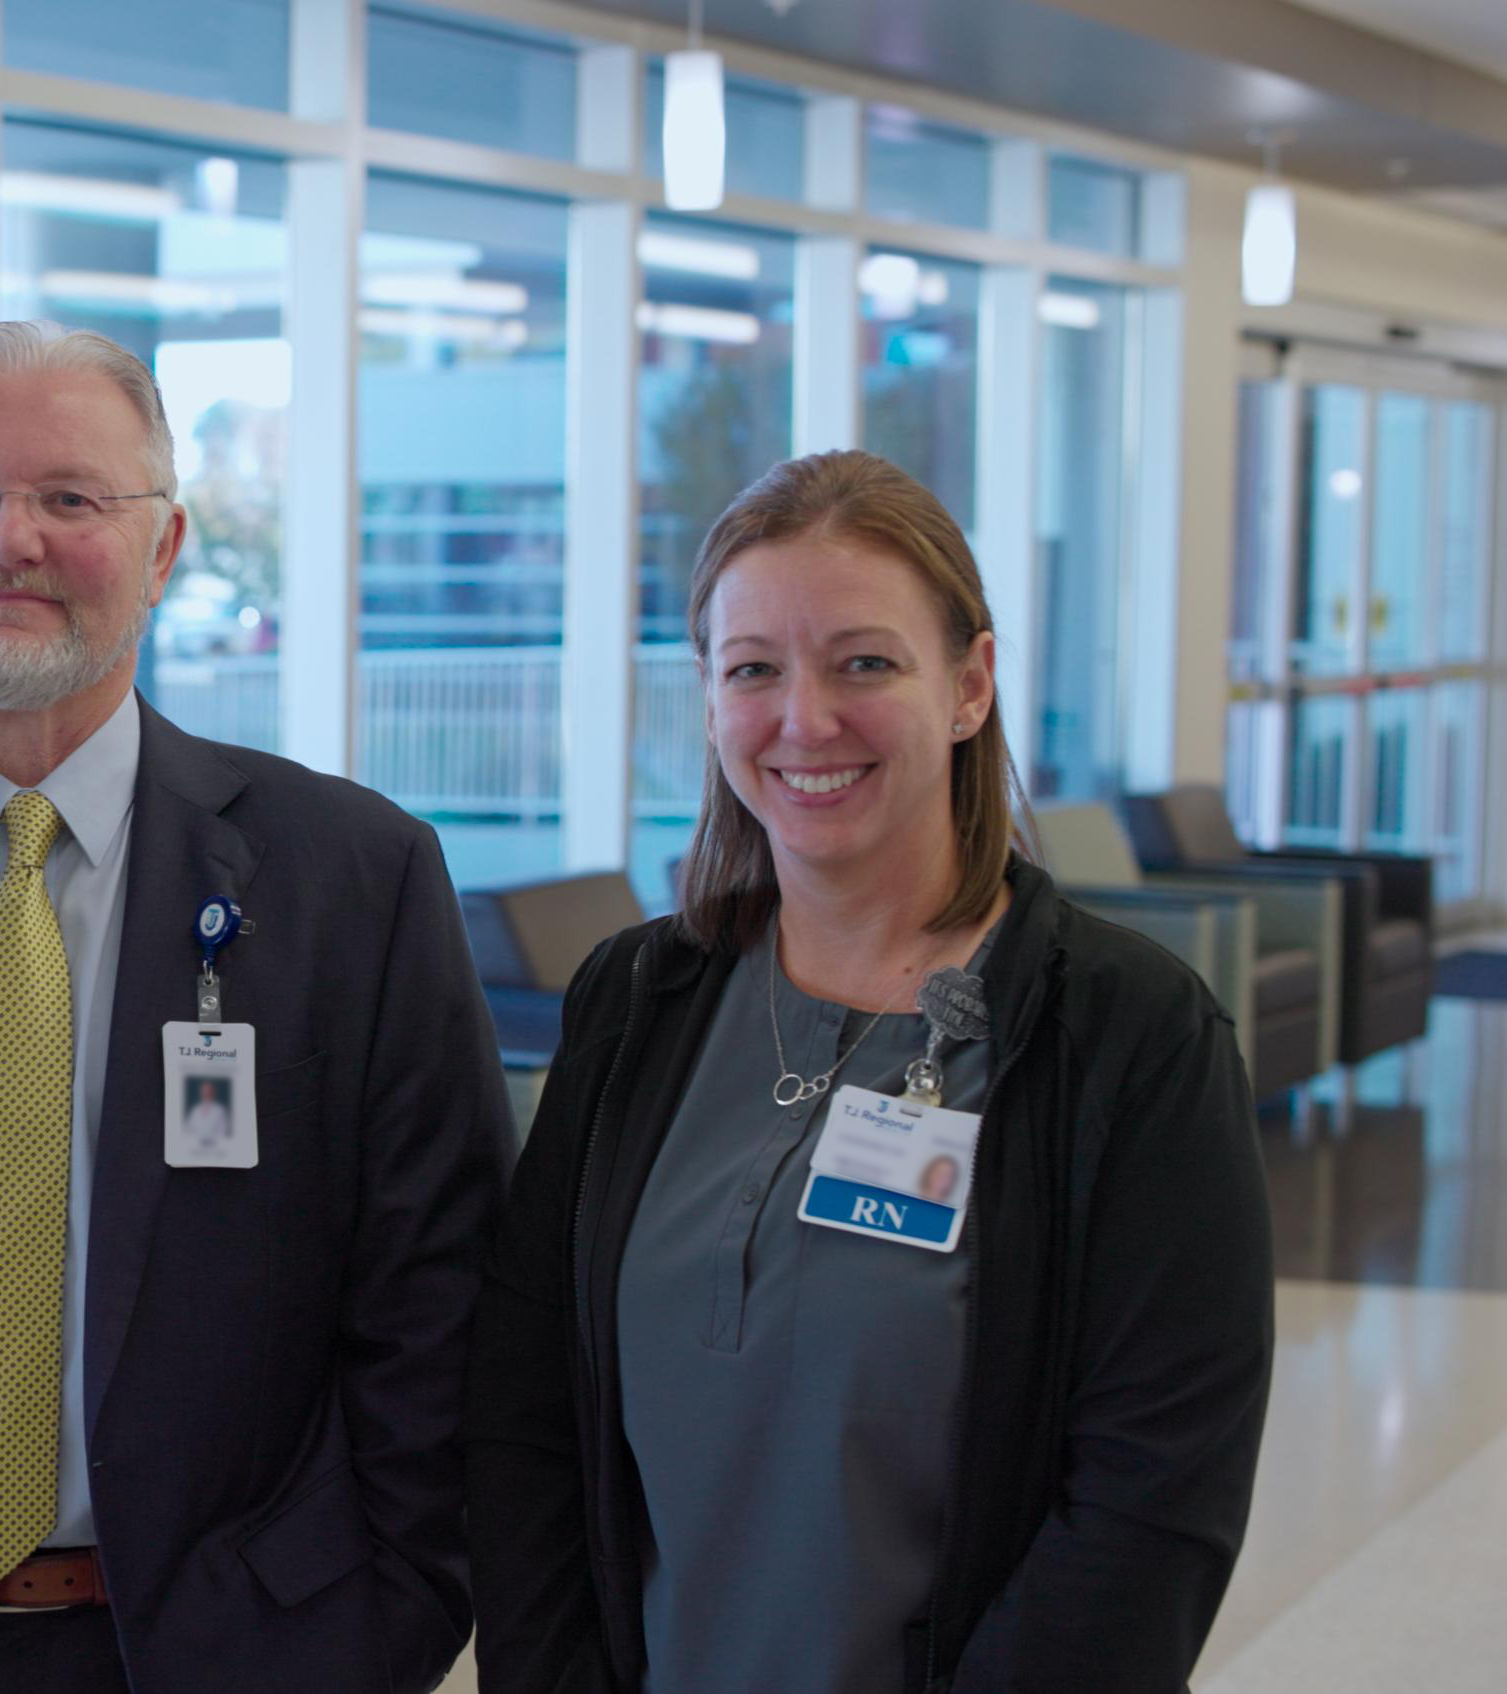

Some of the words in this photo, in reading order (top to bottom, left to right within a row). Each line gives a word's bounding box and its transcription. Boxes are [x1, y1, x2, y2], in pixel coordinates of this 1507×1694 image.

[194, 1047, 237, 1061] Regional
[862, 1110, 915, 1131] Regional
[850, 1196, 908, 1231] RN
